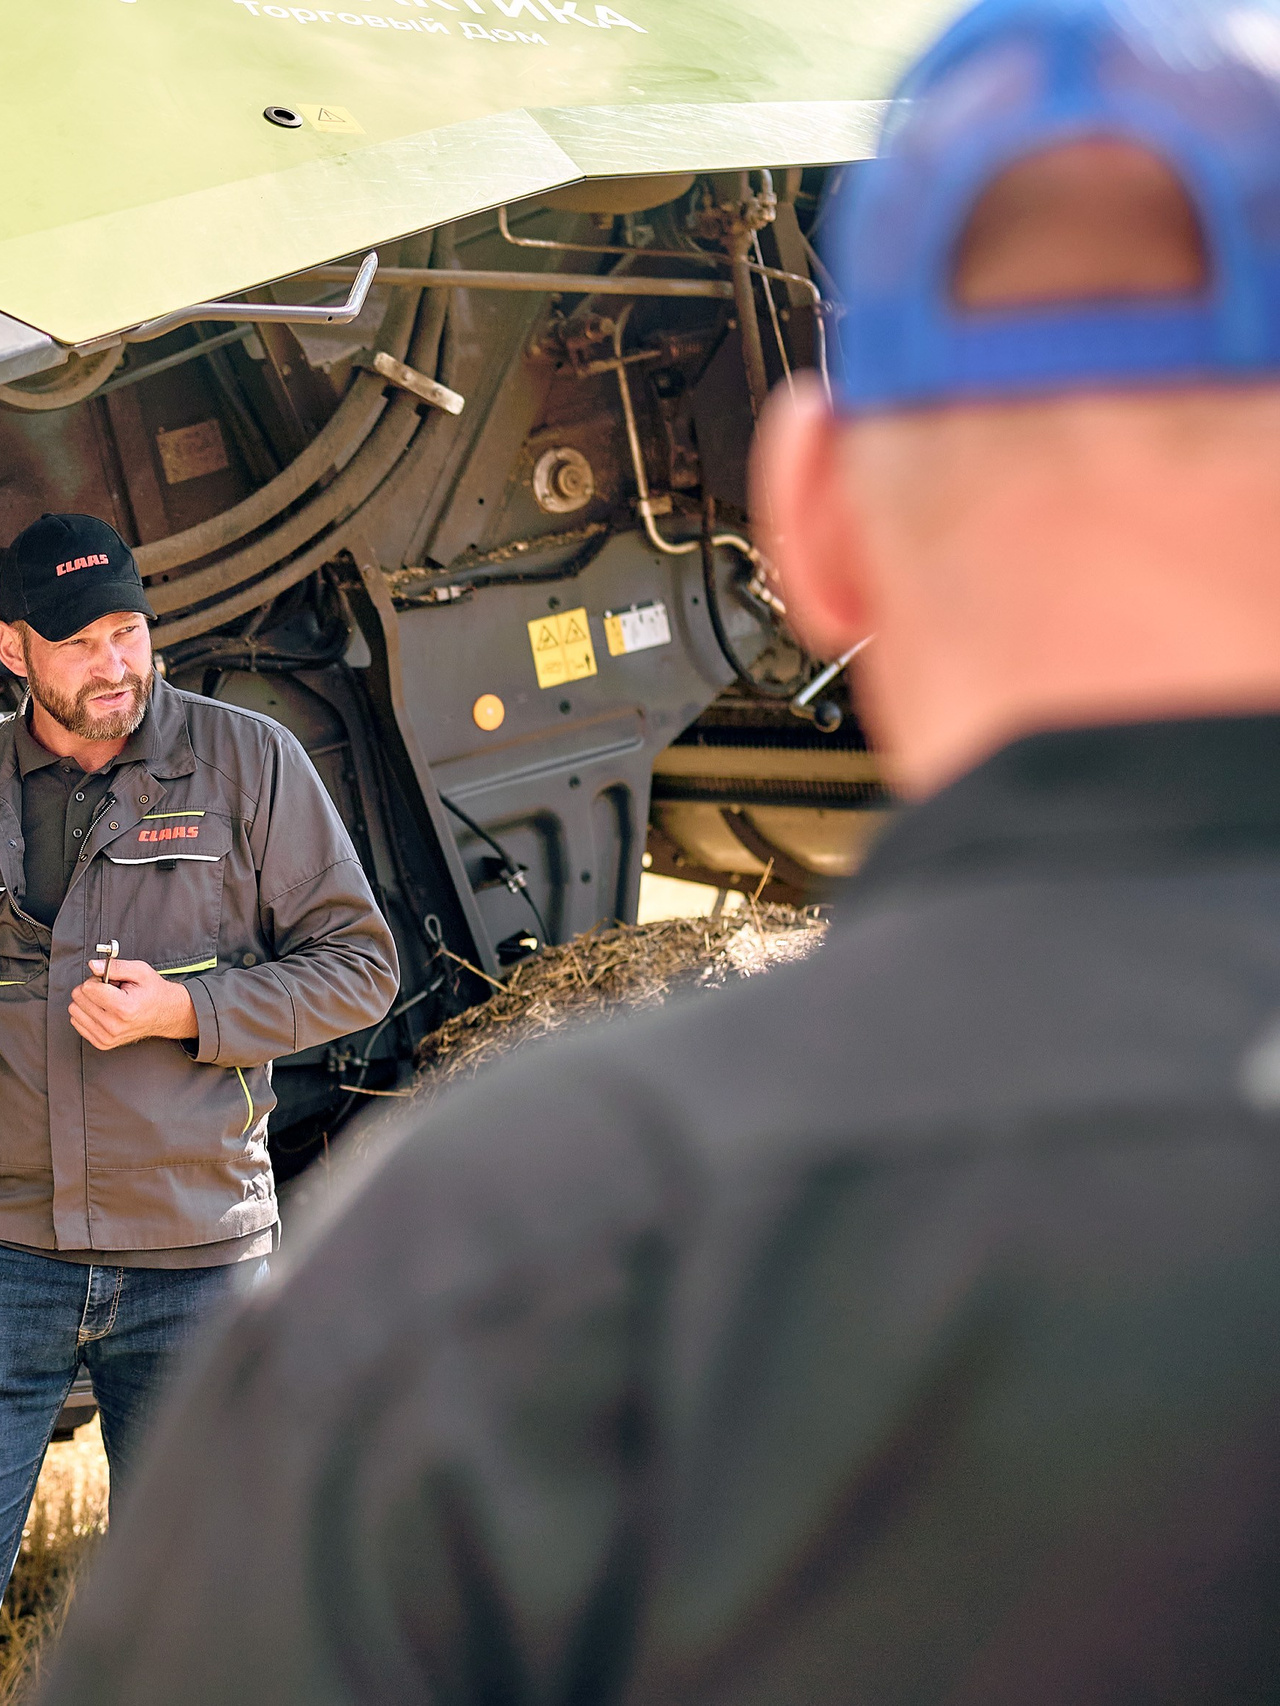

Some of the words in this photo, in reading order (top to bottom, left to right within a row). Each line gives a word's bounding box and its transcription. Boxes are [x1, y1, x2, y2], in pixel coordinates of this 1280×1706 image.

[233, 0, 451, 35] Торговый
[458, 21, 549, 46] Дом
[56, 554, 109, 577] CLAAS
[138, 826, 199, 842] CLAAS
